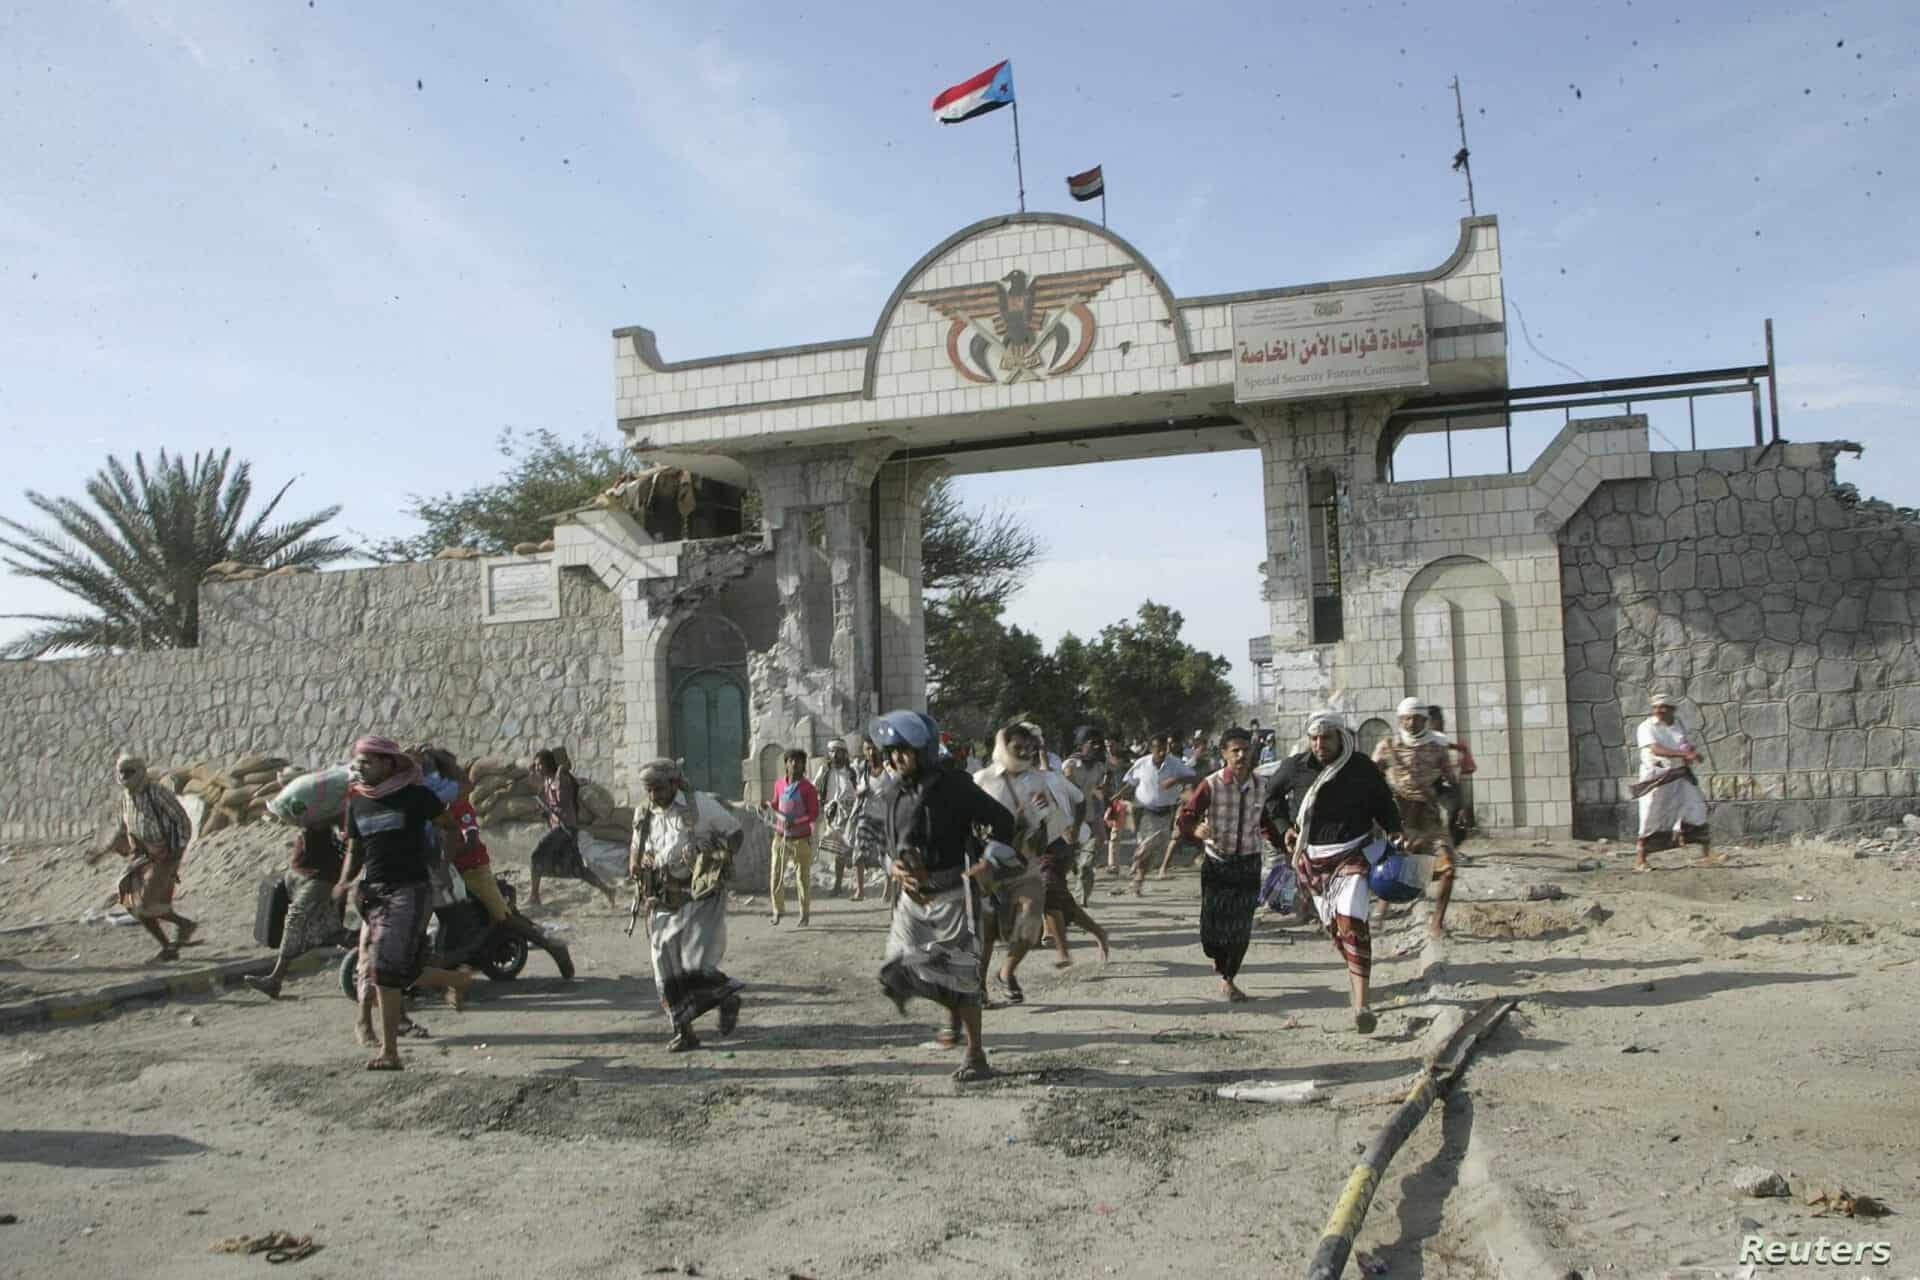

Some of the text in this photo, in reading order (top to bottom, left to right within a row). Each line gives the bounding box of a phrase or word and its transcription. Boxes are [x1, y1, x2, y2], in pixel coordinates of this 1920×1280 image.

[1239, 339, 1294, 364] الخاصة
[1340, 327, 1377, 359] قوات
[1380, 323, 1425, 355] قيادة
[1245, 374, 1280, 391] Special
